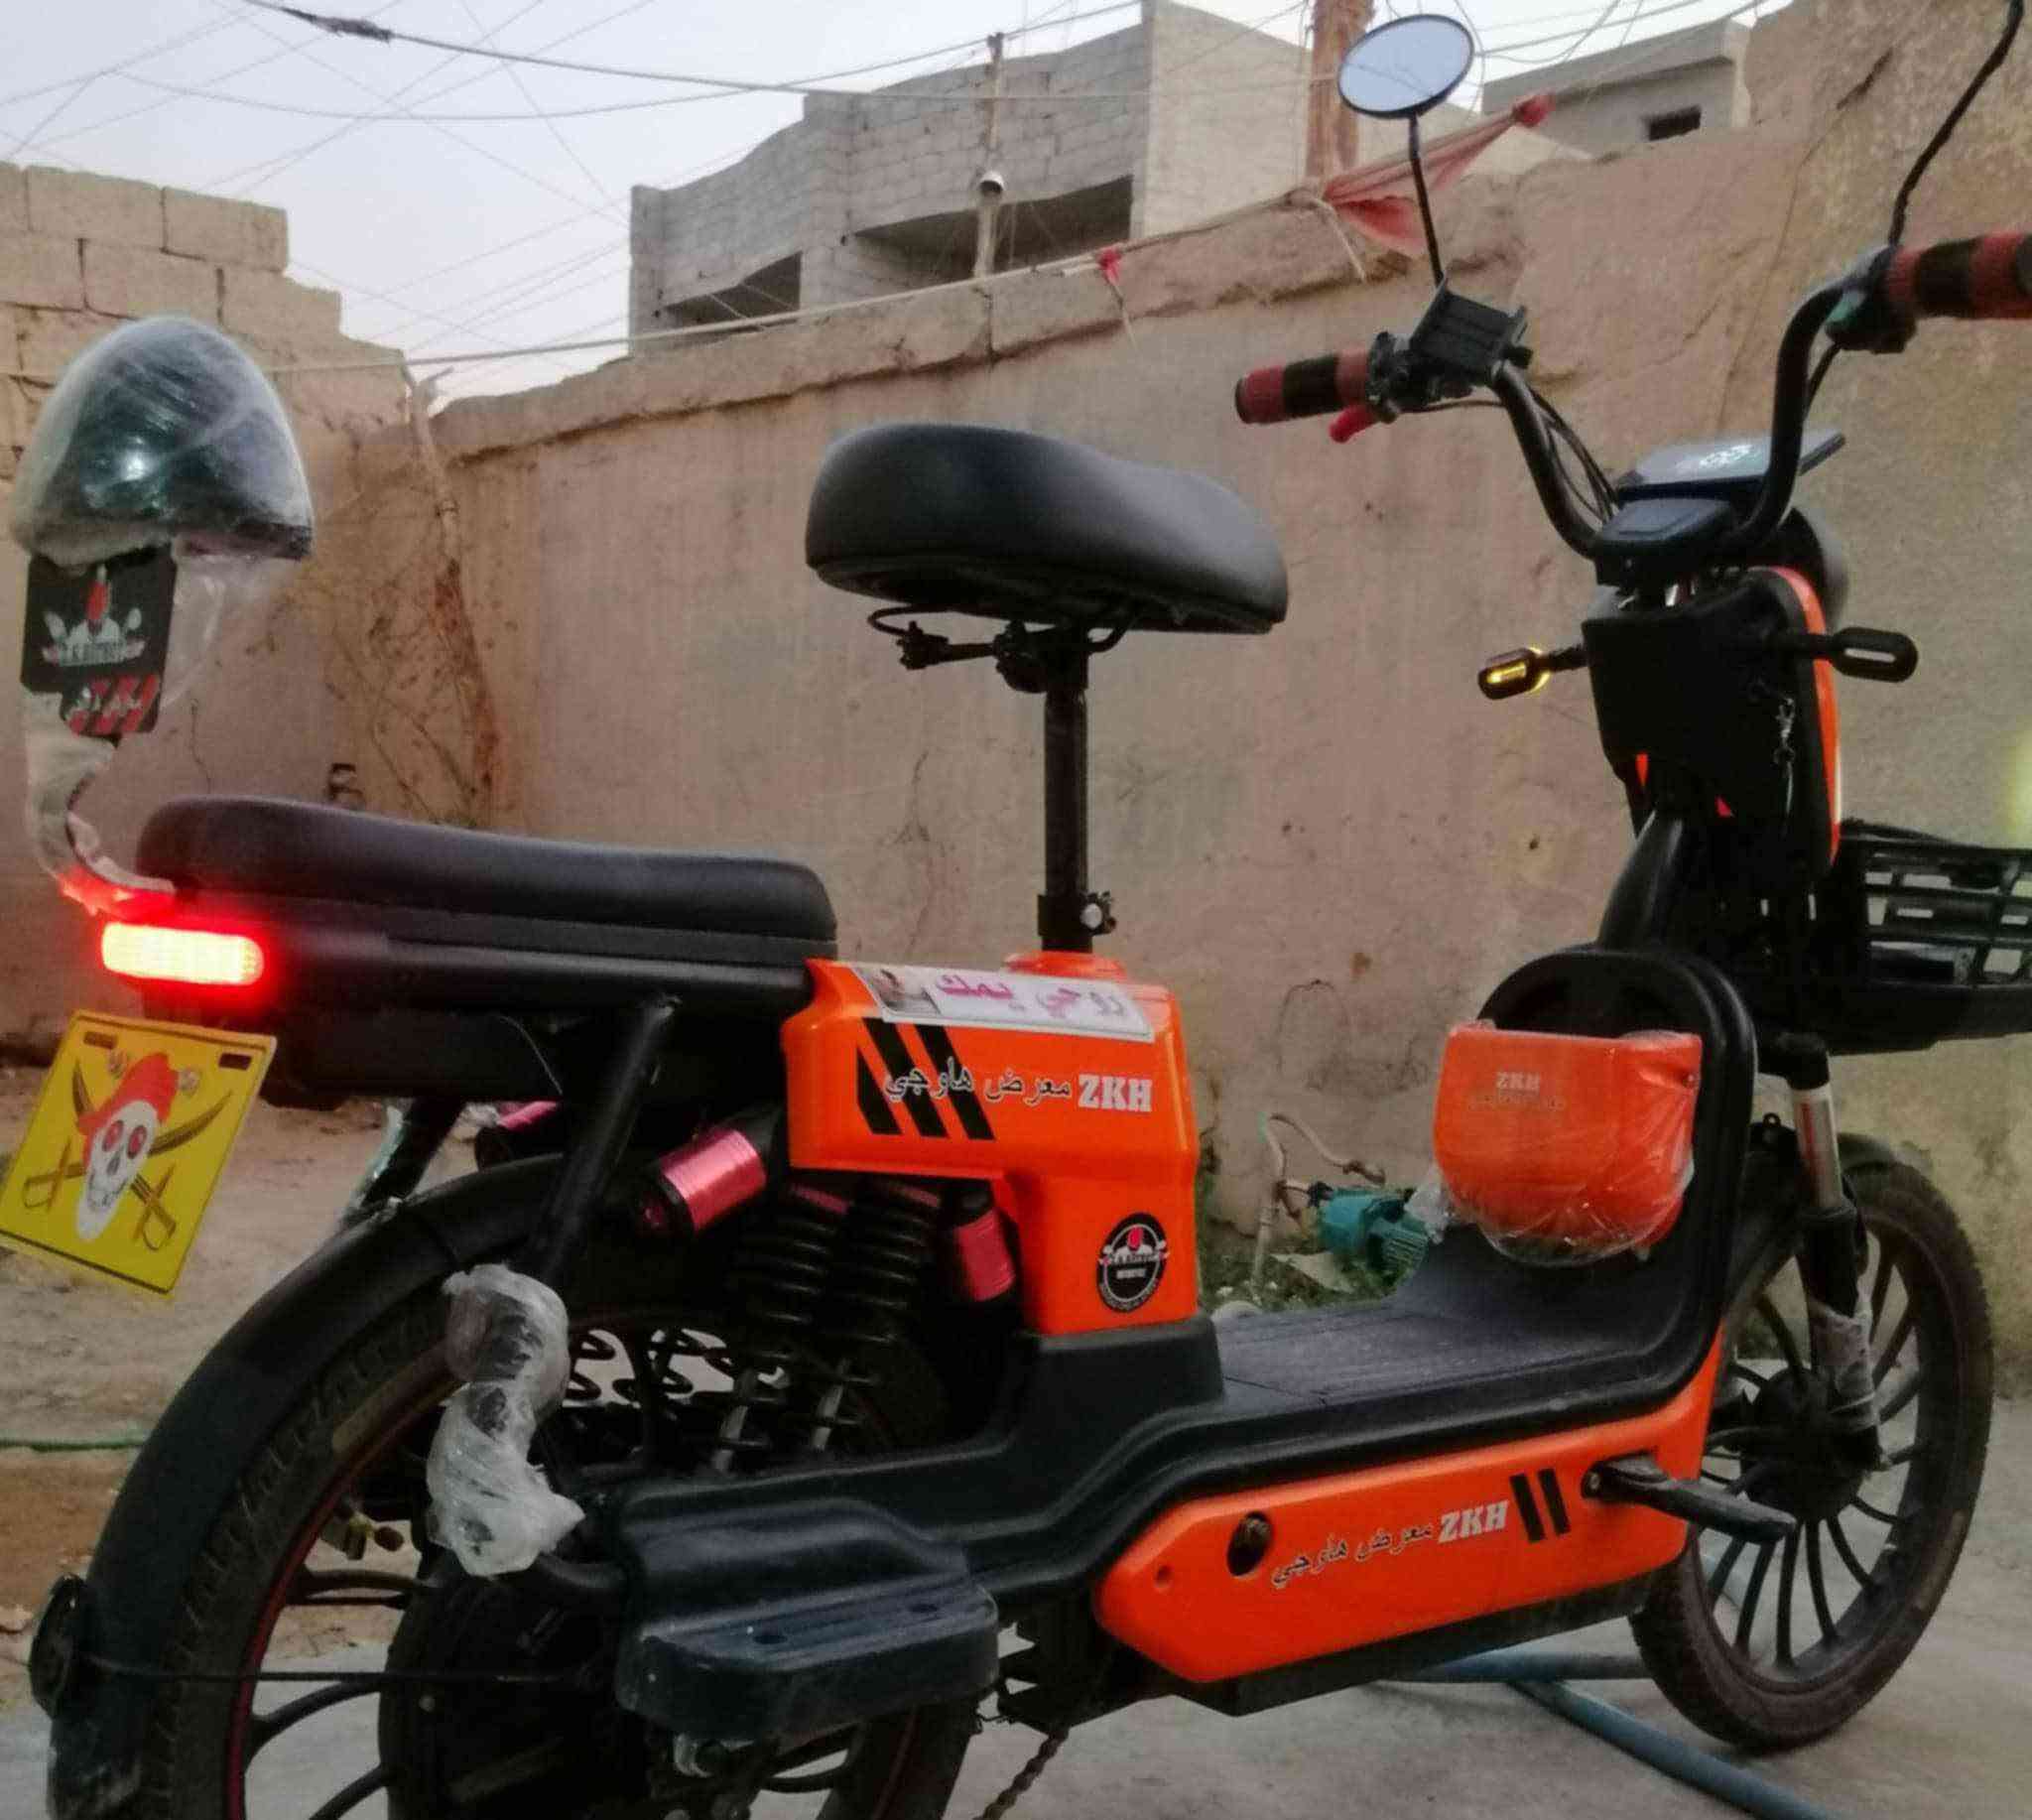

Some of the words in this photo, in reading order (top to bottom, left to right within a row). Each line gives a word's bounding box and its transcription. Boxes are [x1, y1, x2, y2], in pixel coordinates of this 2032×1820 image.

[884, 1056, 973, 1104] هاوجي
[985, 1068, 1071, 1105] معرض
[1078, 1074, 1152, 1112] ZKH
[1439, 1499, 1508, 1544] ZKH
[1355, 1524, 1434, 1561] معرض
